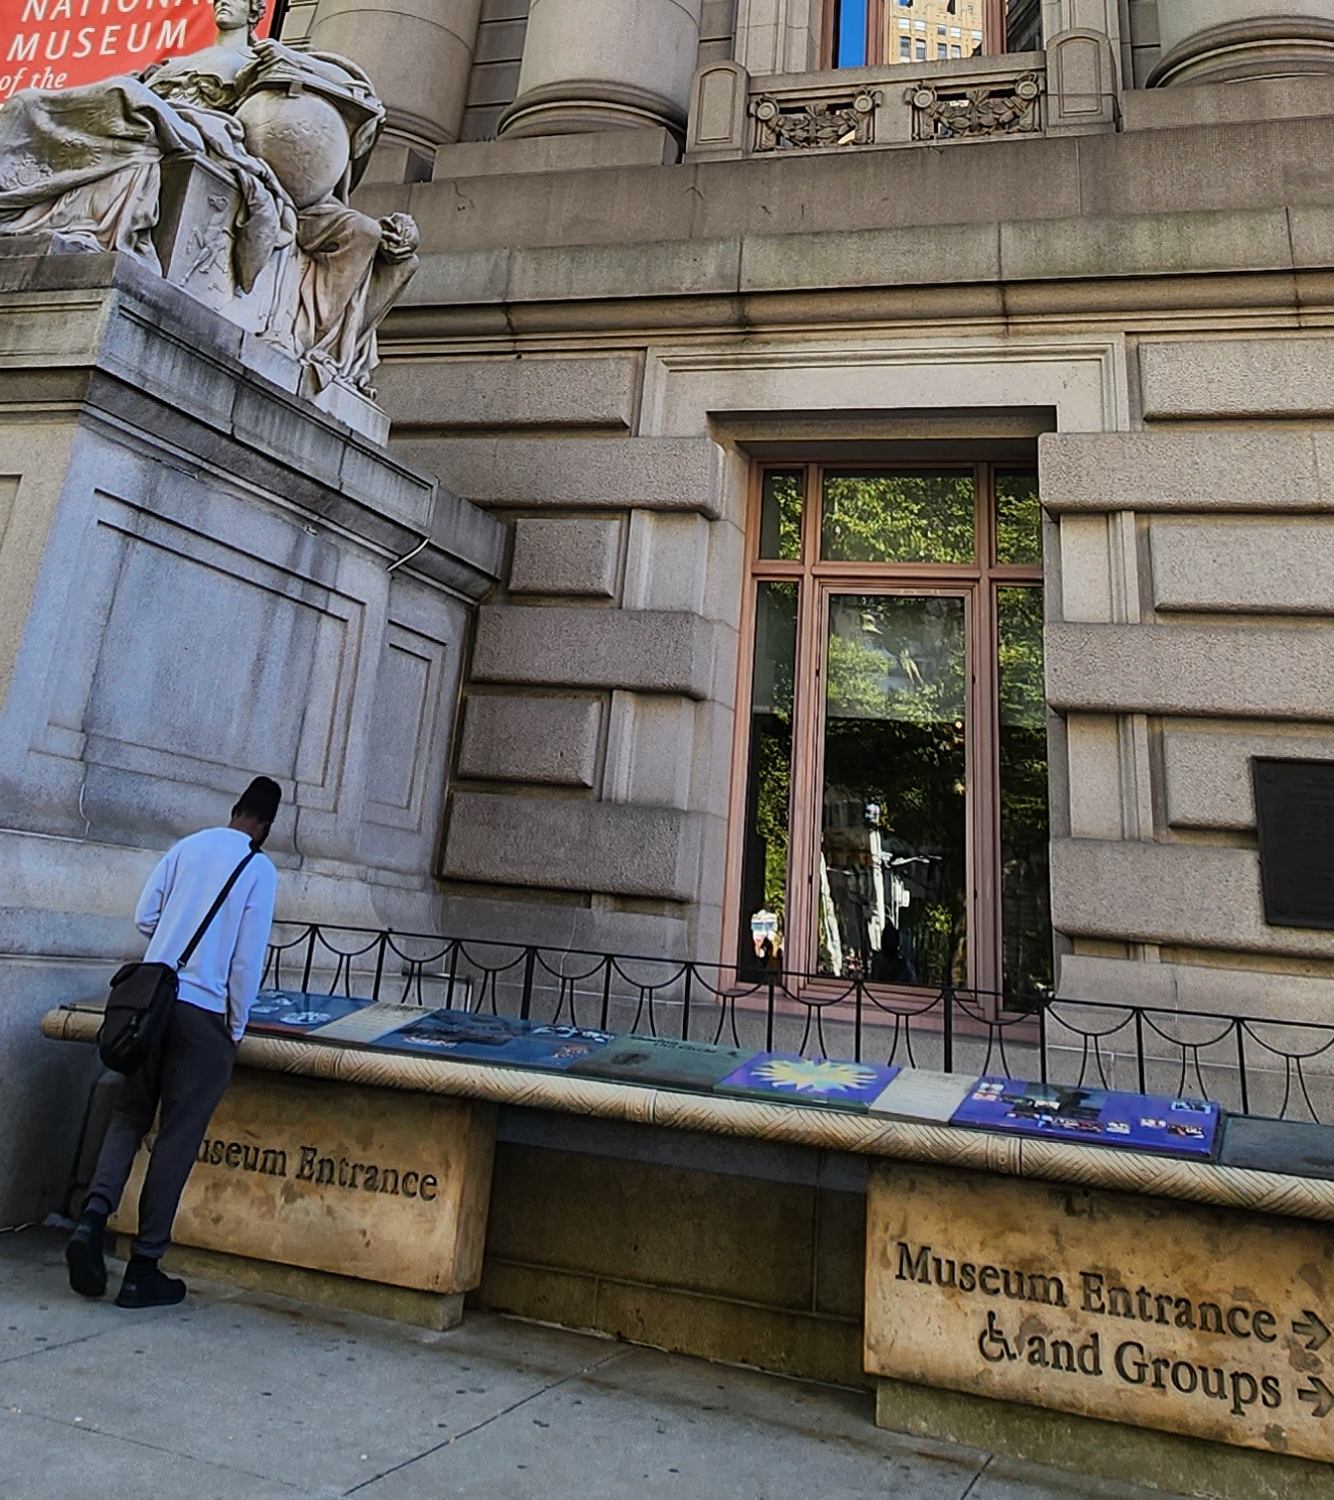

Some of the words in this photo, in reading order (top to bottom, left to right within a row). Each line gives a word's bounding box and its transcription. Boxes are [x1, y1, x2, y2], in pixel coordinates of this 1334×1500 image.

[6, 17, 188, 62] MUSEUM
[30, 66, 68, 90] the
[196, 1138, 287, 1177] useum
[296, 1146, 438, 1201] Entrance
[895, 1241, 1067, 1308] Museum
[1079, 1271, 1278, 1342] Entrance
[1027, 1333, 1104, 1378] and
[1114, 1341, 1284, 1416] Groups
